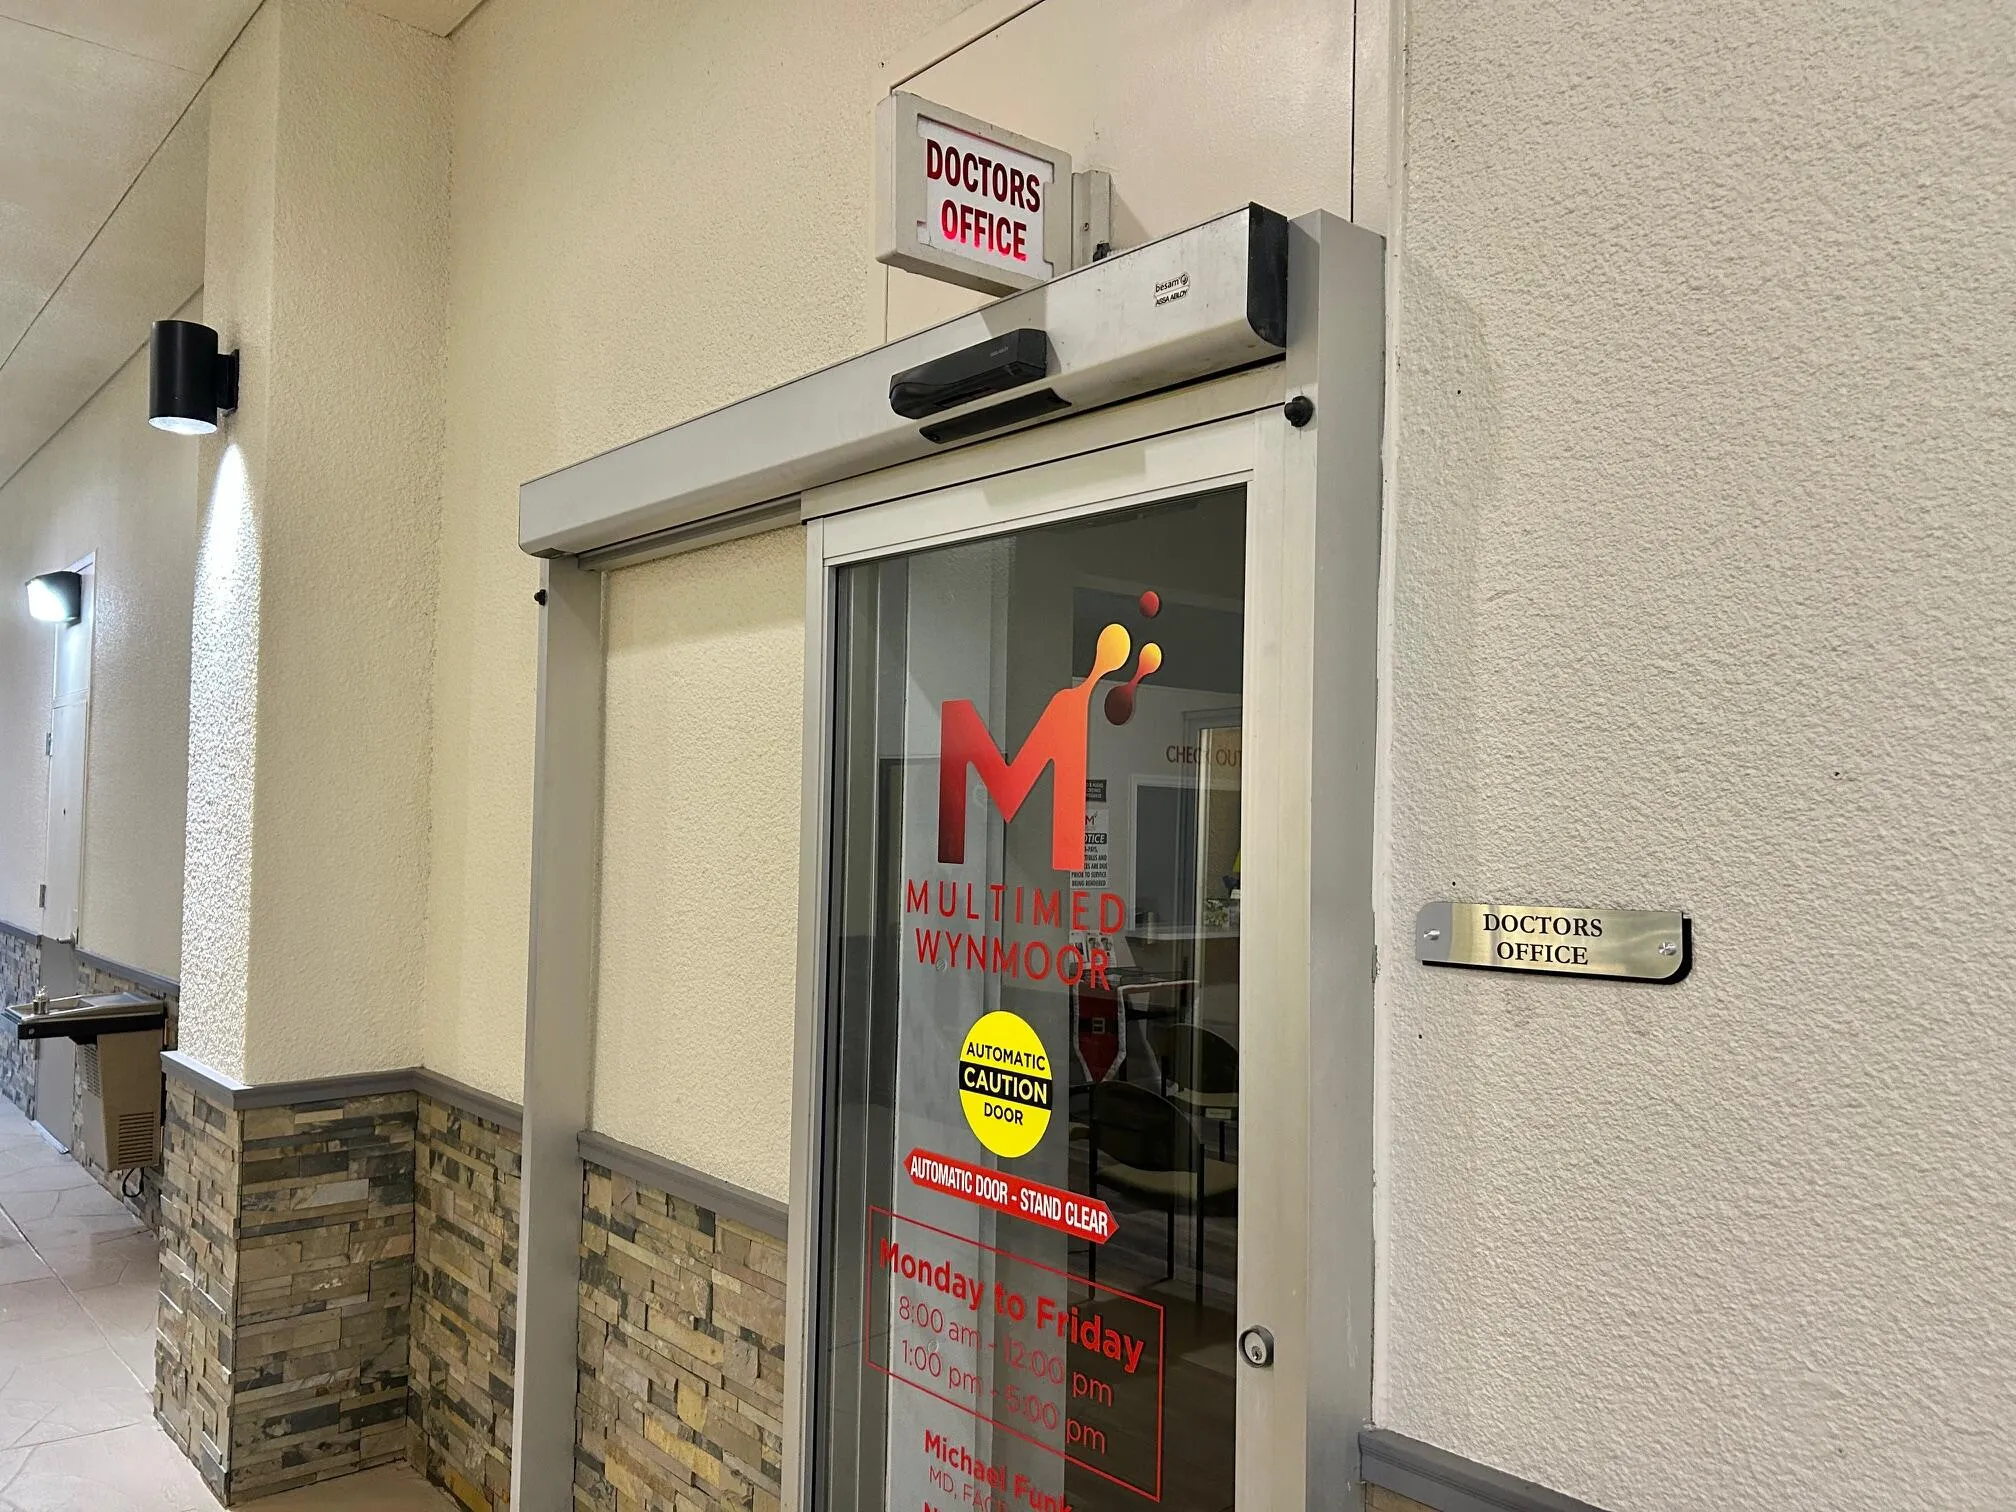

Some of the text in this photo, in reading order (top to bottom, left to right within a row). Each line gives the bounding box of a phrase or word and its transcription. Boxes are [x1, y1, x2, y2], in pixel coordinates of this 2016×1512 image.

[927, 139, 1040, 213] DOCTORS
[941, 200, 1028, 262] OFFICE
[1155, 279, 1179, 293] besam
[1155, 289, 1188, 307] ASSA ABLOY
[1085, 834, 1105, 844] TICE
[906, 879, 1126, 934] MULTIMED
[1482, 913, 1602, 937] DOCTORS
[915, 928, 1110, 991] WYNMOOR
[1497, 942, 1588, 965] OFFICE
[966, 1041, 1046, 1071] AUTOMATIC
[964, 1066, 1047, 1105] CAUTION
[984, 1102, 1023, 1126] DOOR
[910, 1154, 972, 1193] AUTOMATIC
[975, 1177, 1008, 1205] DOOR
[1020, 1188, 1061, 1221] STAND
[1065, 1202, 1108, 1236] CLEAR
[879, 1238, 1144, 1374] Monday to Friday
[899, 1296, 944, 1333] 8:00
[949, 1322, 982, 1351] am
[1003, 1336, 1065, 1385] 12:00
[1071, 1371, 1113, 1407] pm
[902, 1340, 942, 1377] 1:00
[949, 1365, 983, 1397] pm
[1005, 1384, 1058, 1430] 5:00
[1067, 1417, 1106, 1454] pm
[925, 1429, 1073, 1512] Michael Funk
[929, 1465, 957, 1499] MD,
